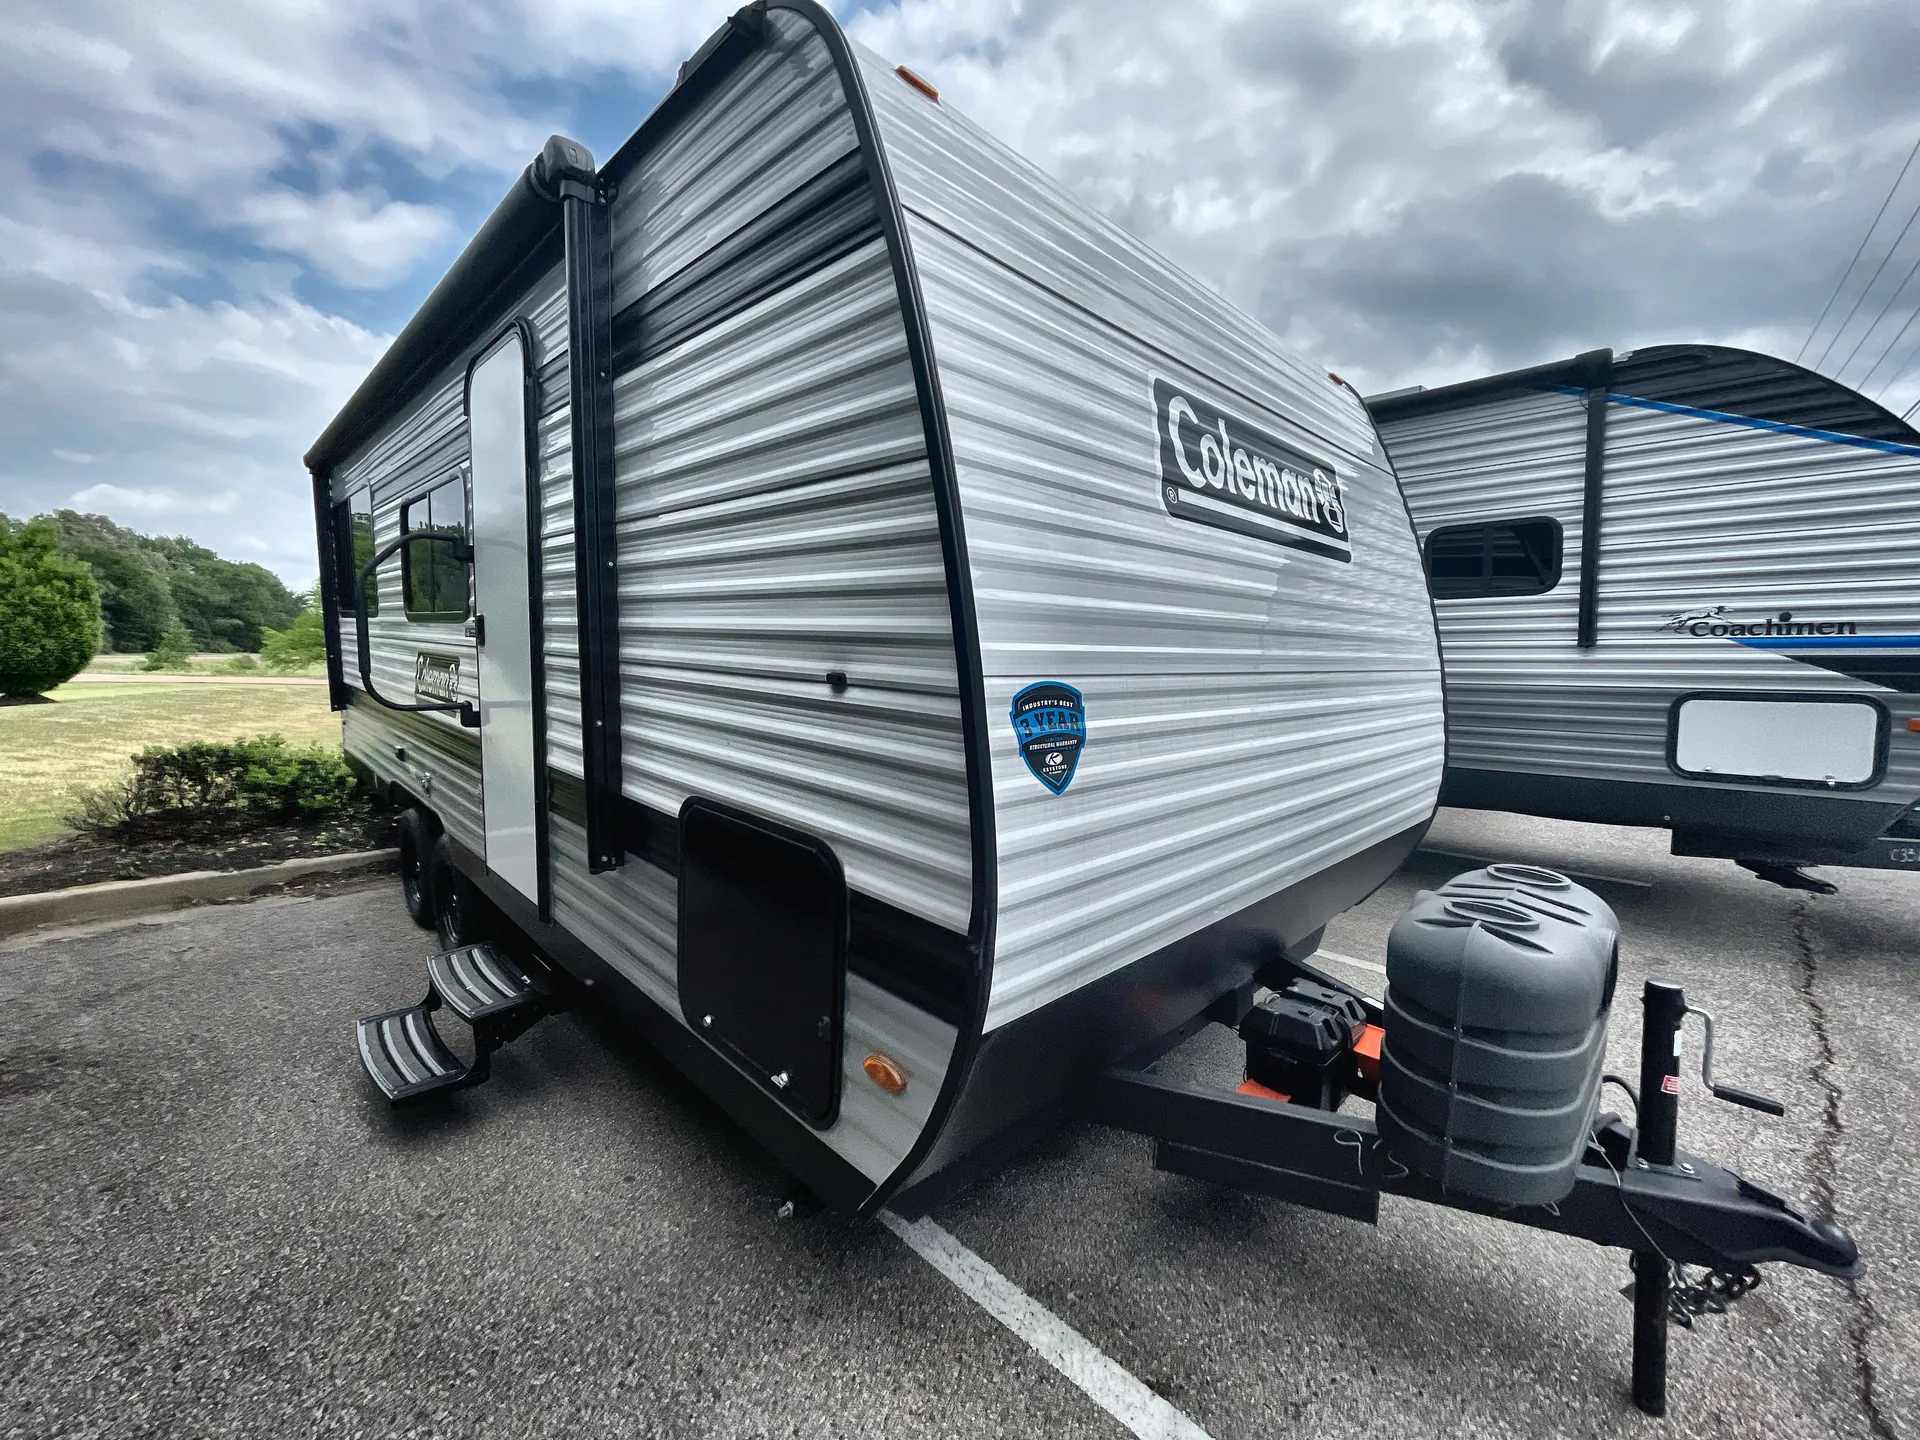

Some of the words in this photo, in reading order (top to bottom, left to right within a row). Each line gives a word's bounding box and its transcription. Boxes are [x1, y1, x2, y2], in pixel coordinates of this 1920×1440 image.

[1168, 395, 1321, 524] Coleman
[1688, 612, 1857, 637] Coachmen
[1022, 700, 1058, 711] INDUSTRY'S
[1059, 700, 1074, 708] BEST
[1020, 718, 1033, 738] 3
[1034, 711, 1081, 732] YEAR
[1029, 742, 1056, 751] STRUCTURAL
[1056, 739, 1078, 748] WARRANTY
[1042, 764, 1068, 773] KEYSTONE
